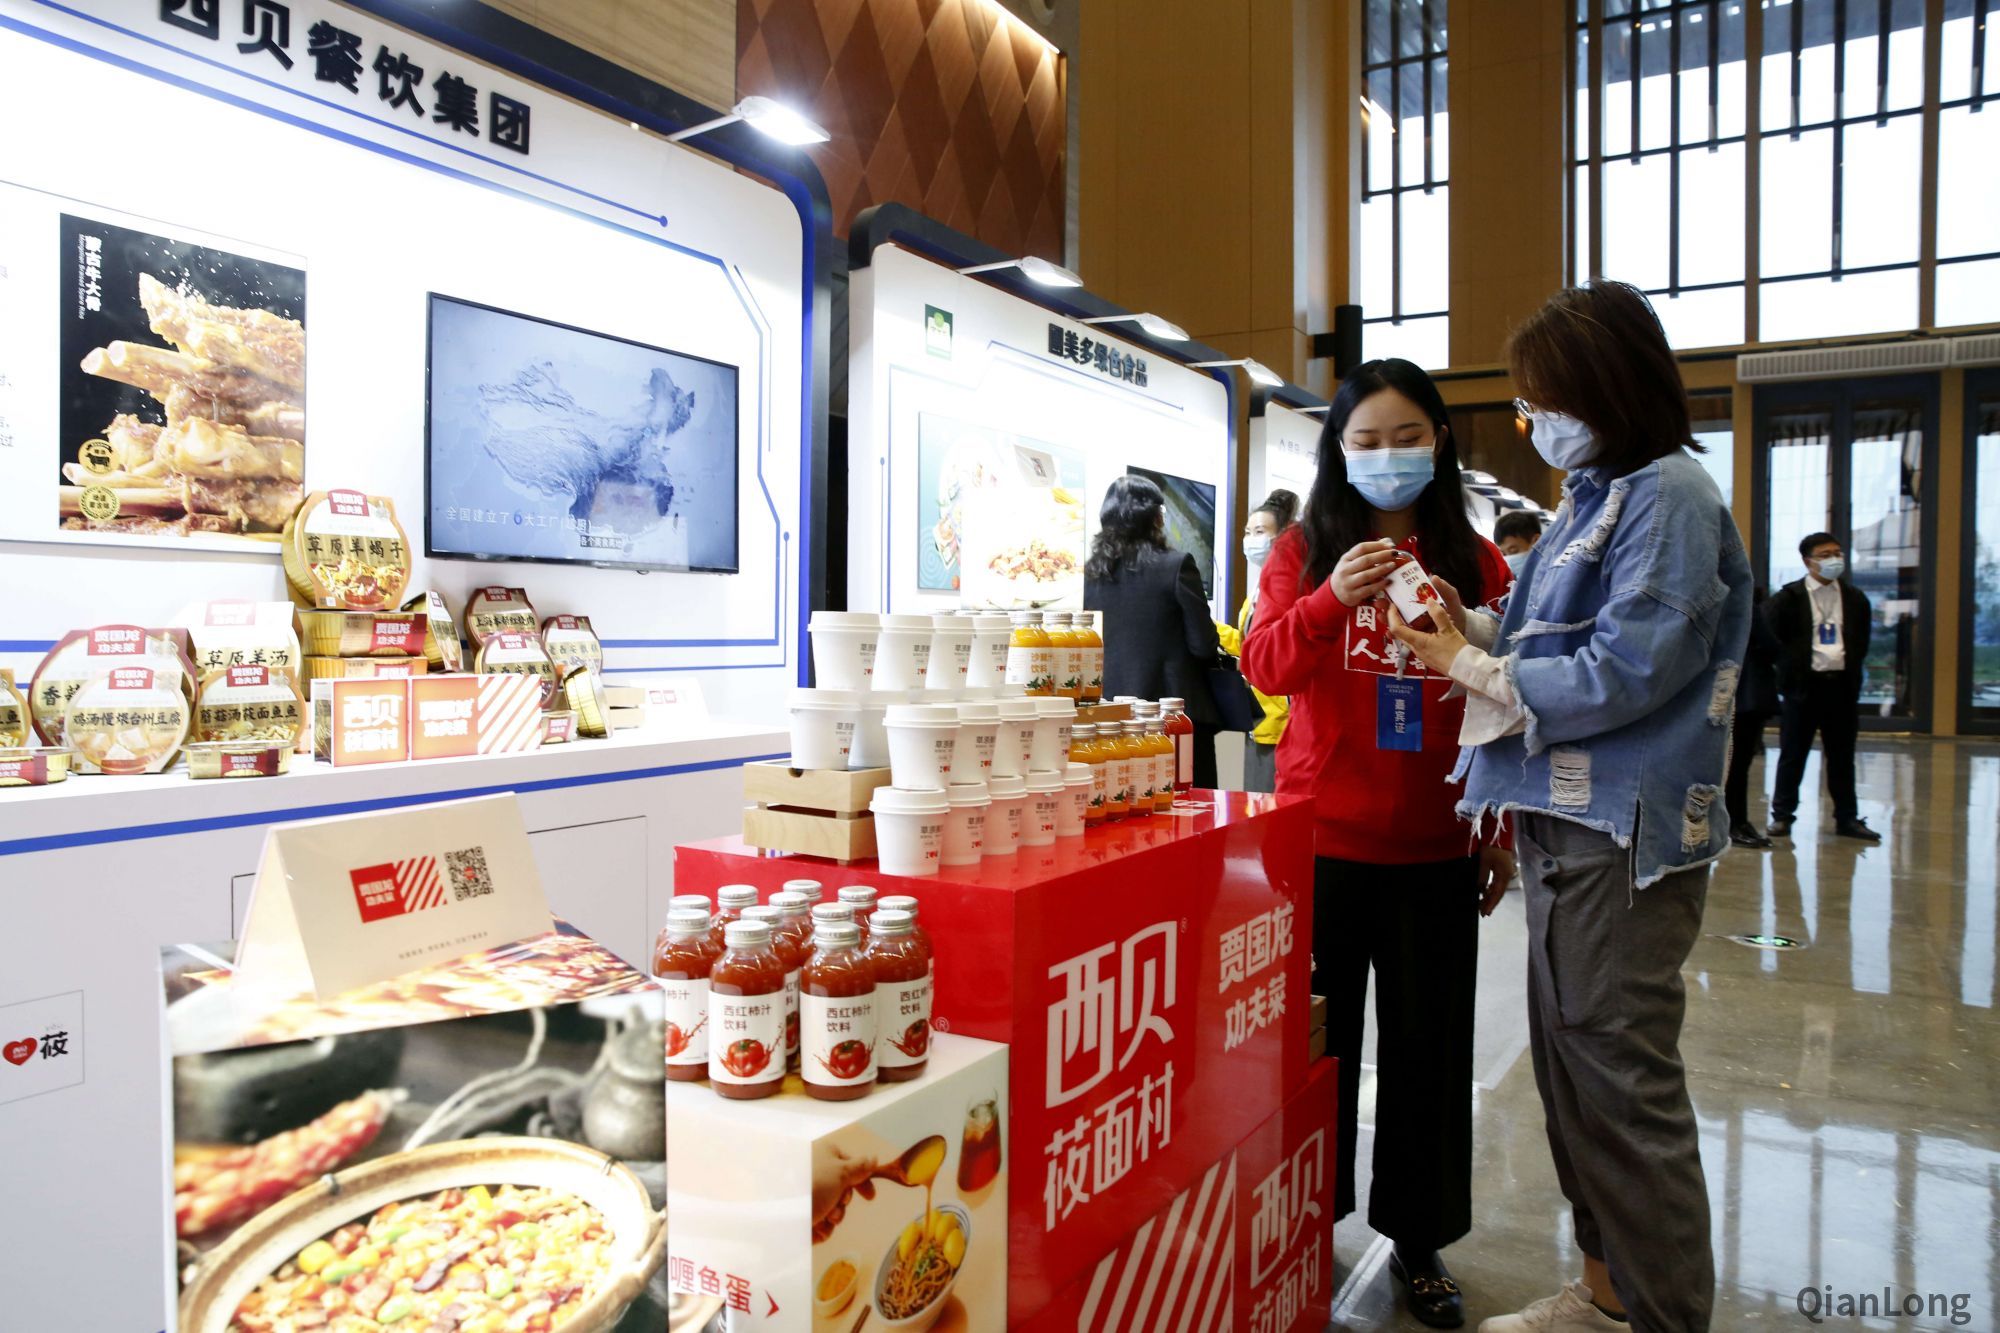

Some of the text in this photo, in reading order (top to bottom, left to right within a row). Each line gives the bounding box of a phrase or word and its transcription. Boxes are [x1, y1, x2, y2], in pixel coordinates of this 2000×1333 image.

[307, 535, 404, 559] 草原羊蝎子
[204, 649, 289, 668] 草原羊汤
[1219, 900, 1294, 994] 贾国龙
[723, 1003, 772, 1018] 西红柿汁
[826, 1003, 872, 1019] 西红柿汁
[900, 1003, 920, 1016] 饮料
[1045, 919, 1178, 1109] 西贝
[1223, 971, 1287, 1054] 功夫菜
[723, 1019, 748, 1032] 饮料
[826, 1021, 851, 1033] 饮料
[1043, 1060, 1175, 1233] 莜面村
[1250, 1127, 1325, 1290] 西贝
